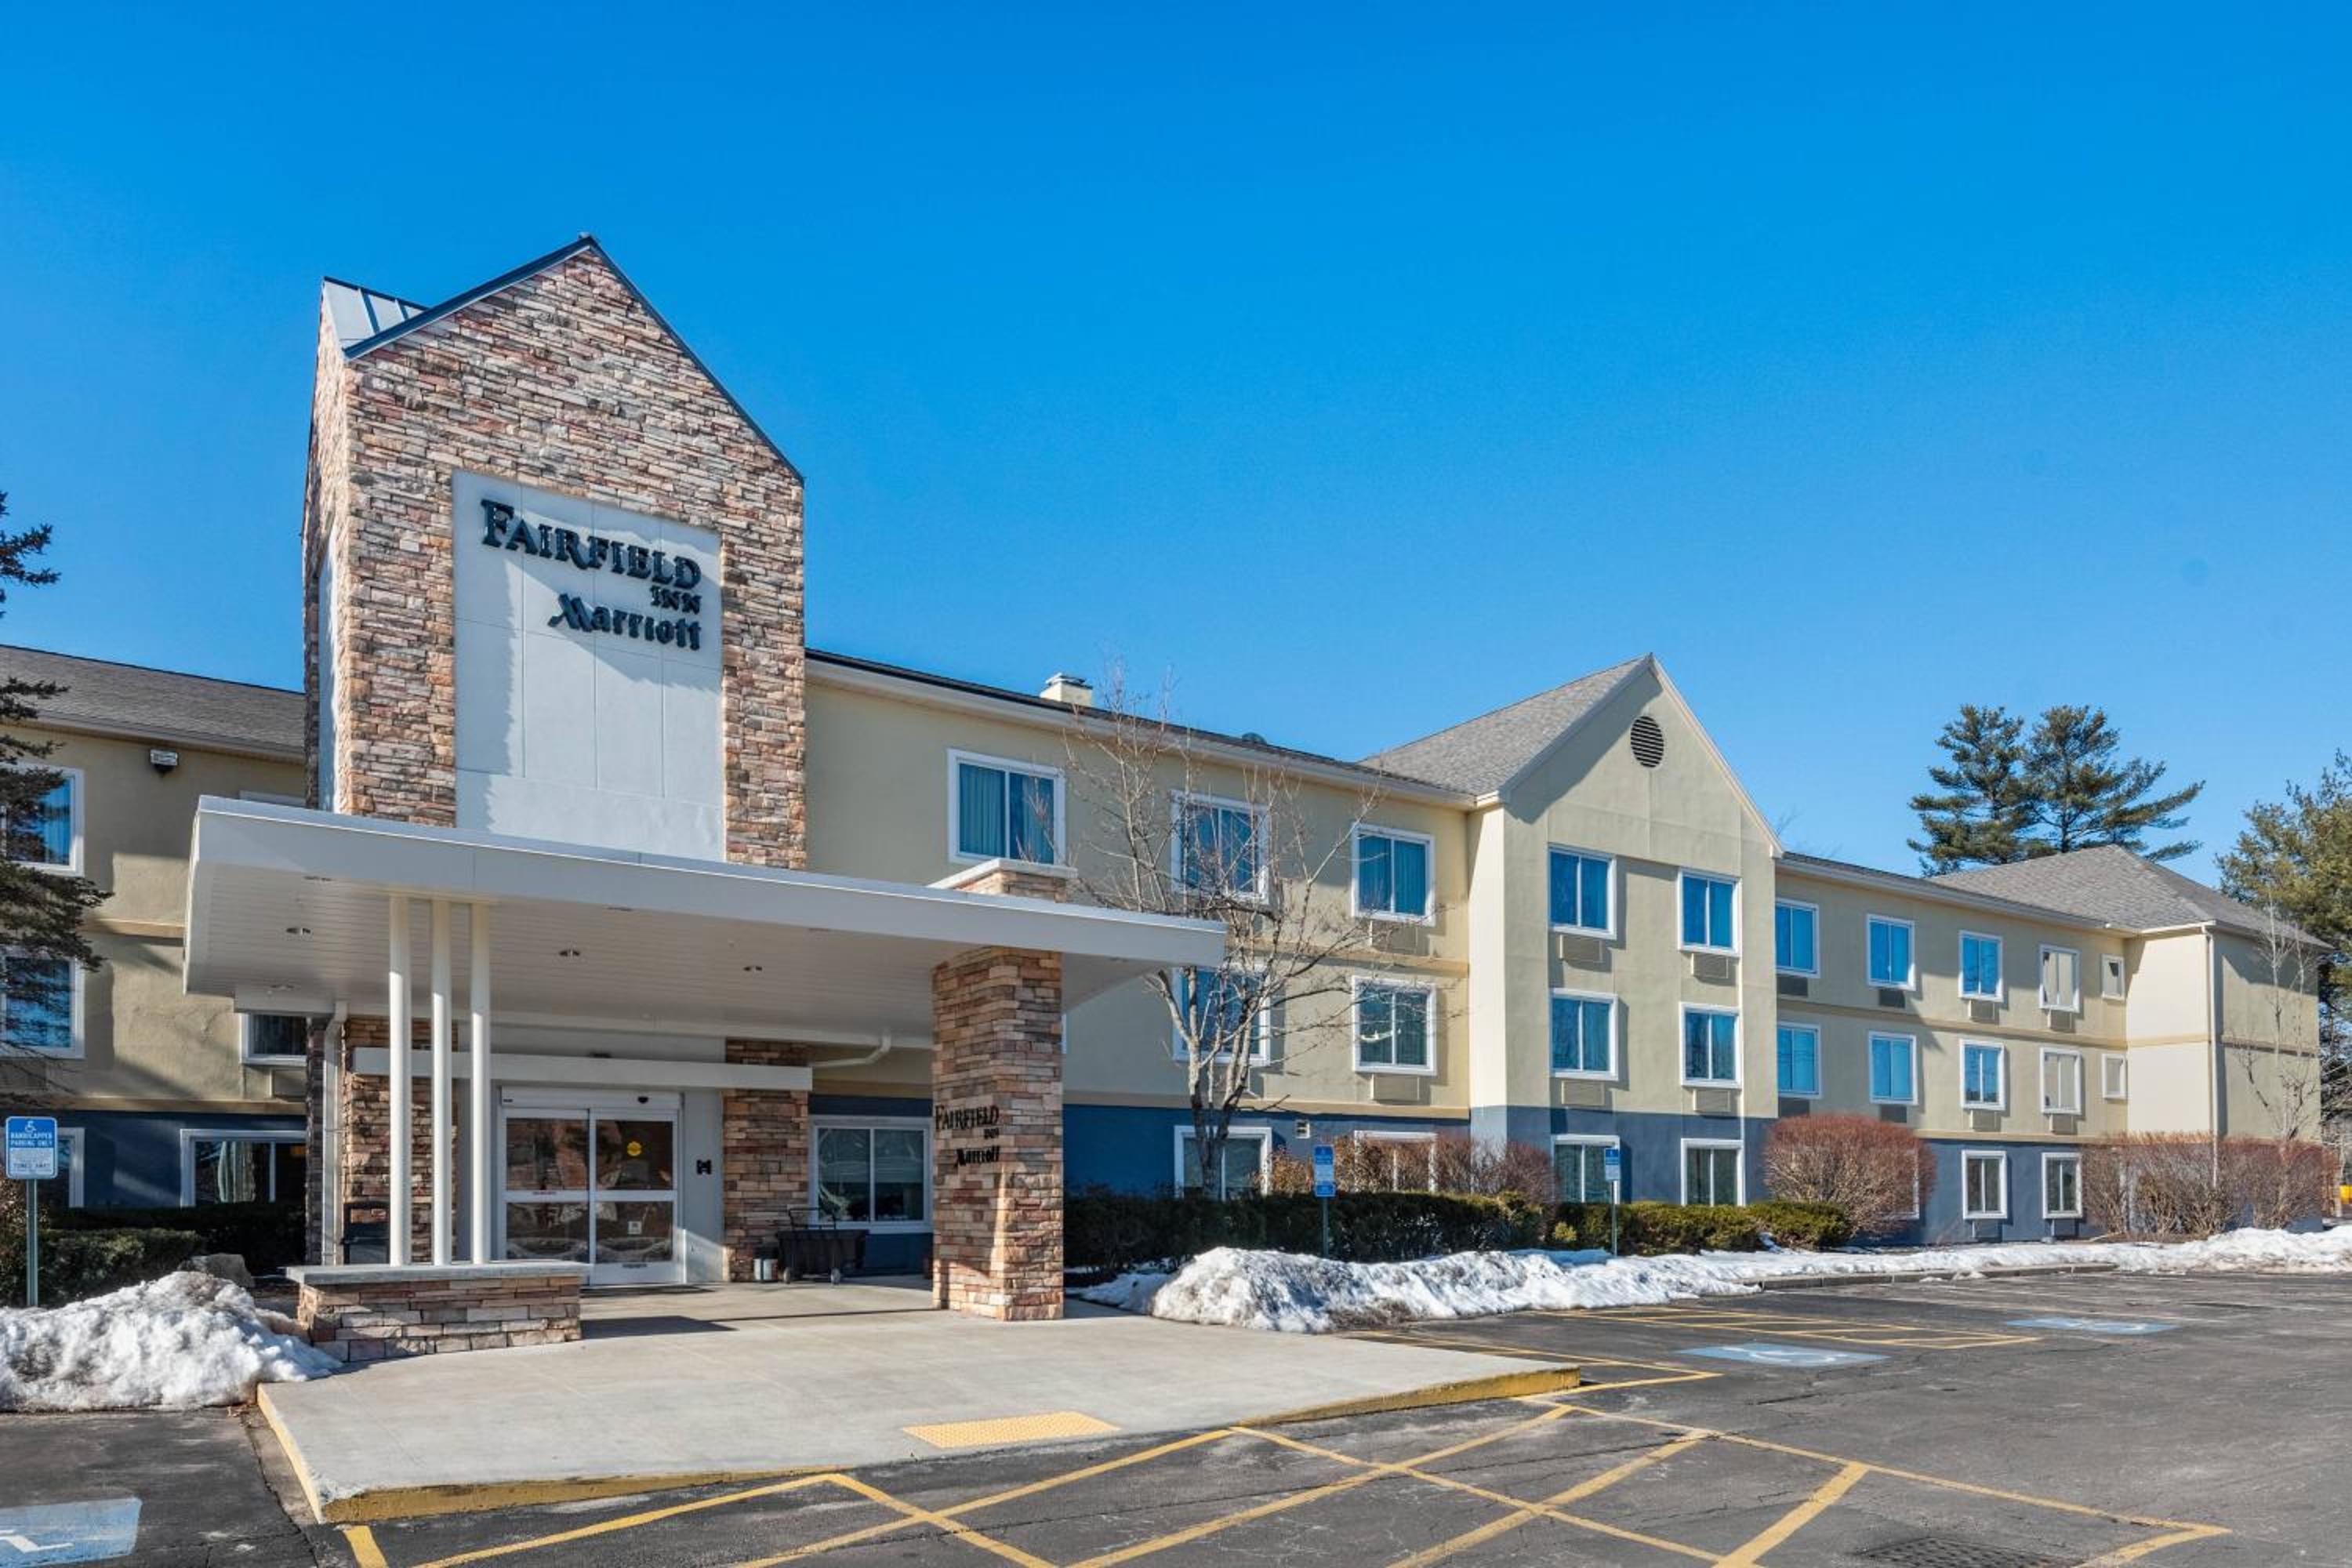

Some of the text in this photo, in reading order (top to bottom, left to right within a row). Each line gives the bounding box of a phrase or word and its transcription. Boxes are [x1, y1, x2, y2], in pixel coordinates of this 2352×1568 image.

[481, 499, 702, 589] FAIRFIELD
[548, 593, 702, 651] Marriott
[650, 585, 702, 615] INN
[935, 1104, 1000, 1131] FAIRFIELD
